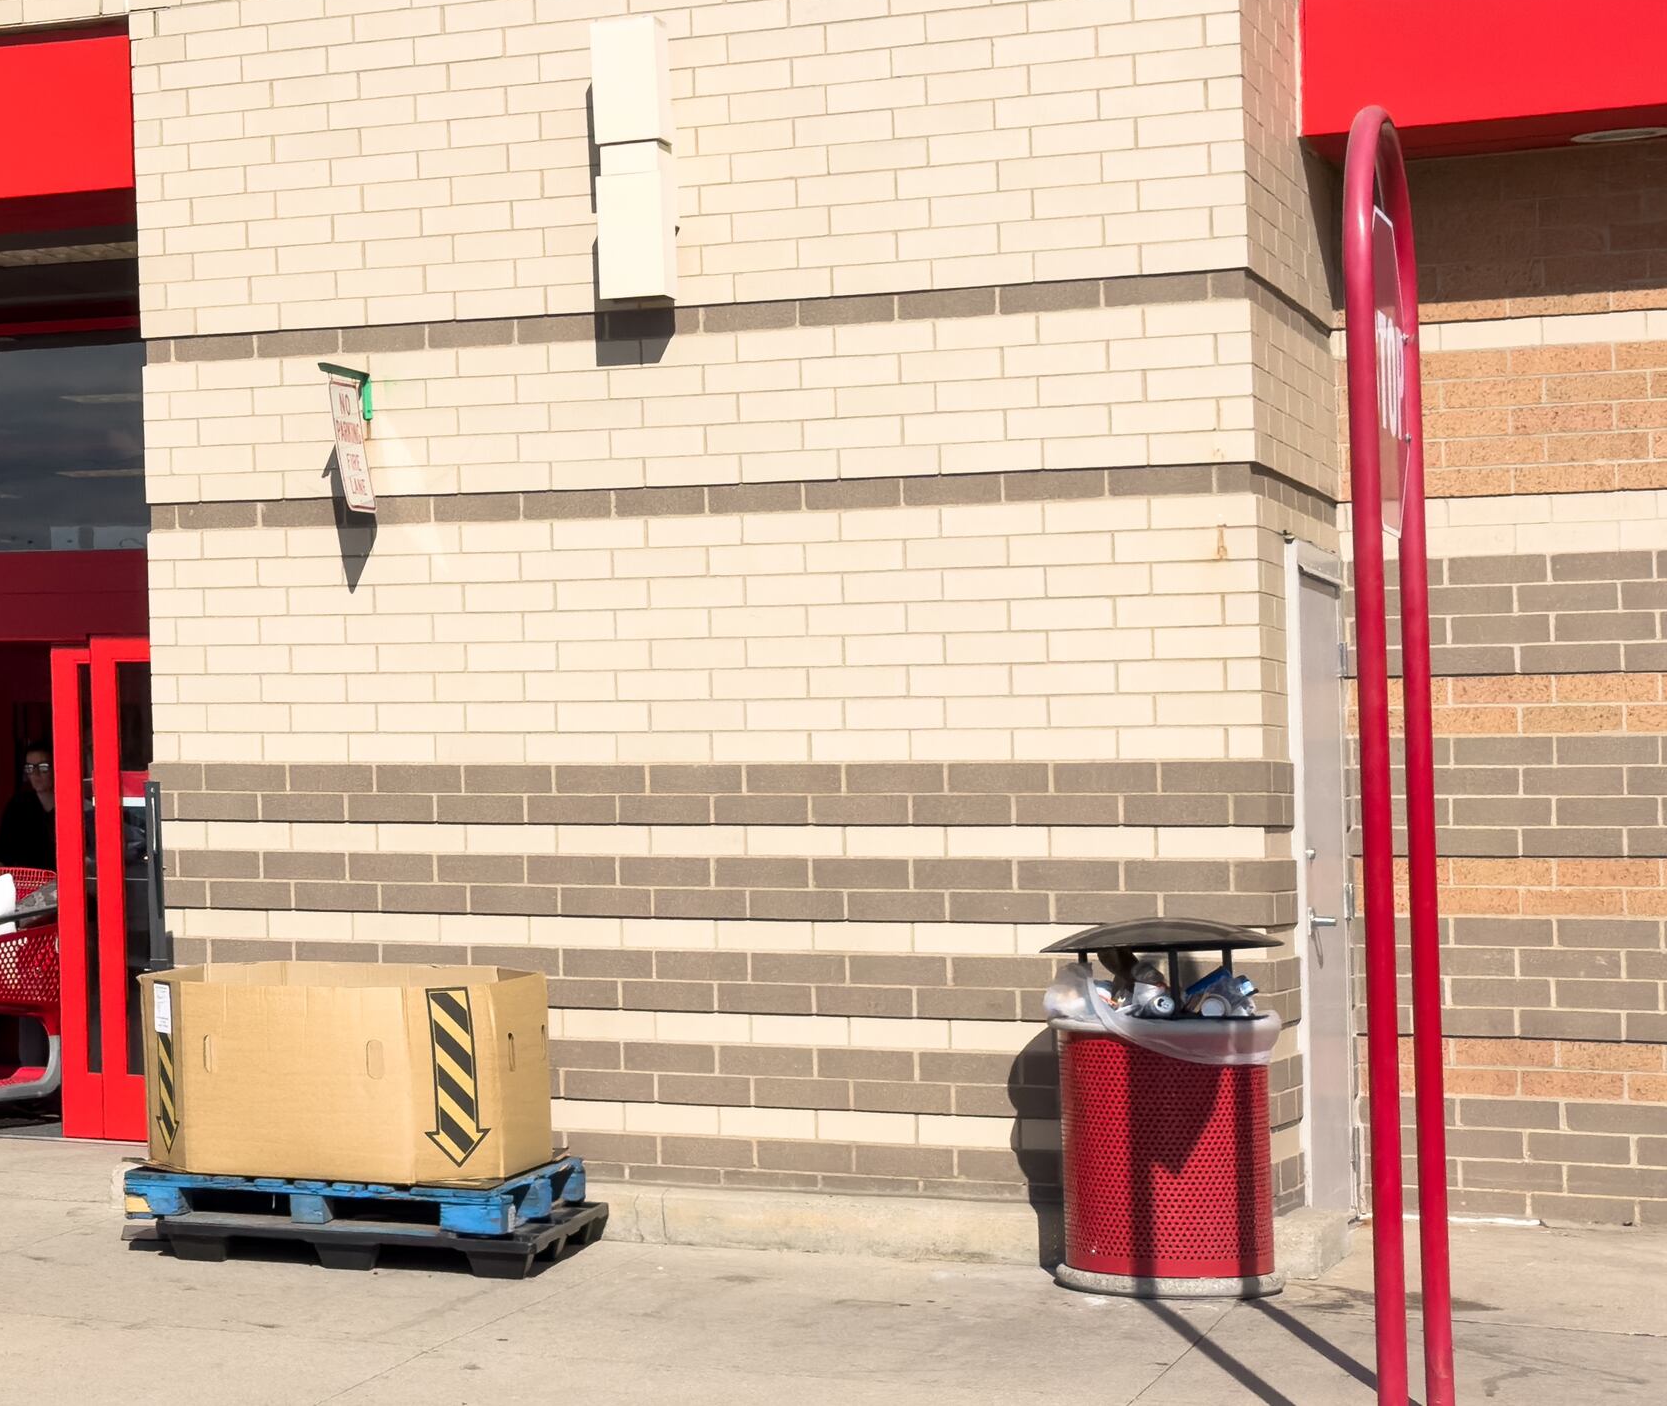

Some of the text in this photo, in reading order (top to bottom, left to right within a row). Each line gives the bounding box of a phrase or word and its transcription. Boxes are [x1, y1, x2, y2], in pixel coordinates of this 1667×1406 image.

[338, 393, 351, 416] NO
[335, 419, 362, 444] PARKING
[346, 453, 363, 472] FIRE
[349, 477, 368, 496] LANE
